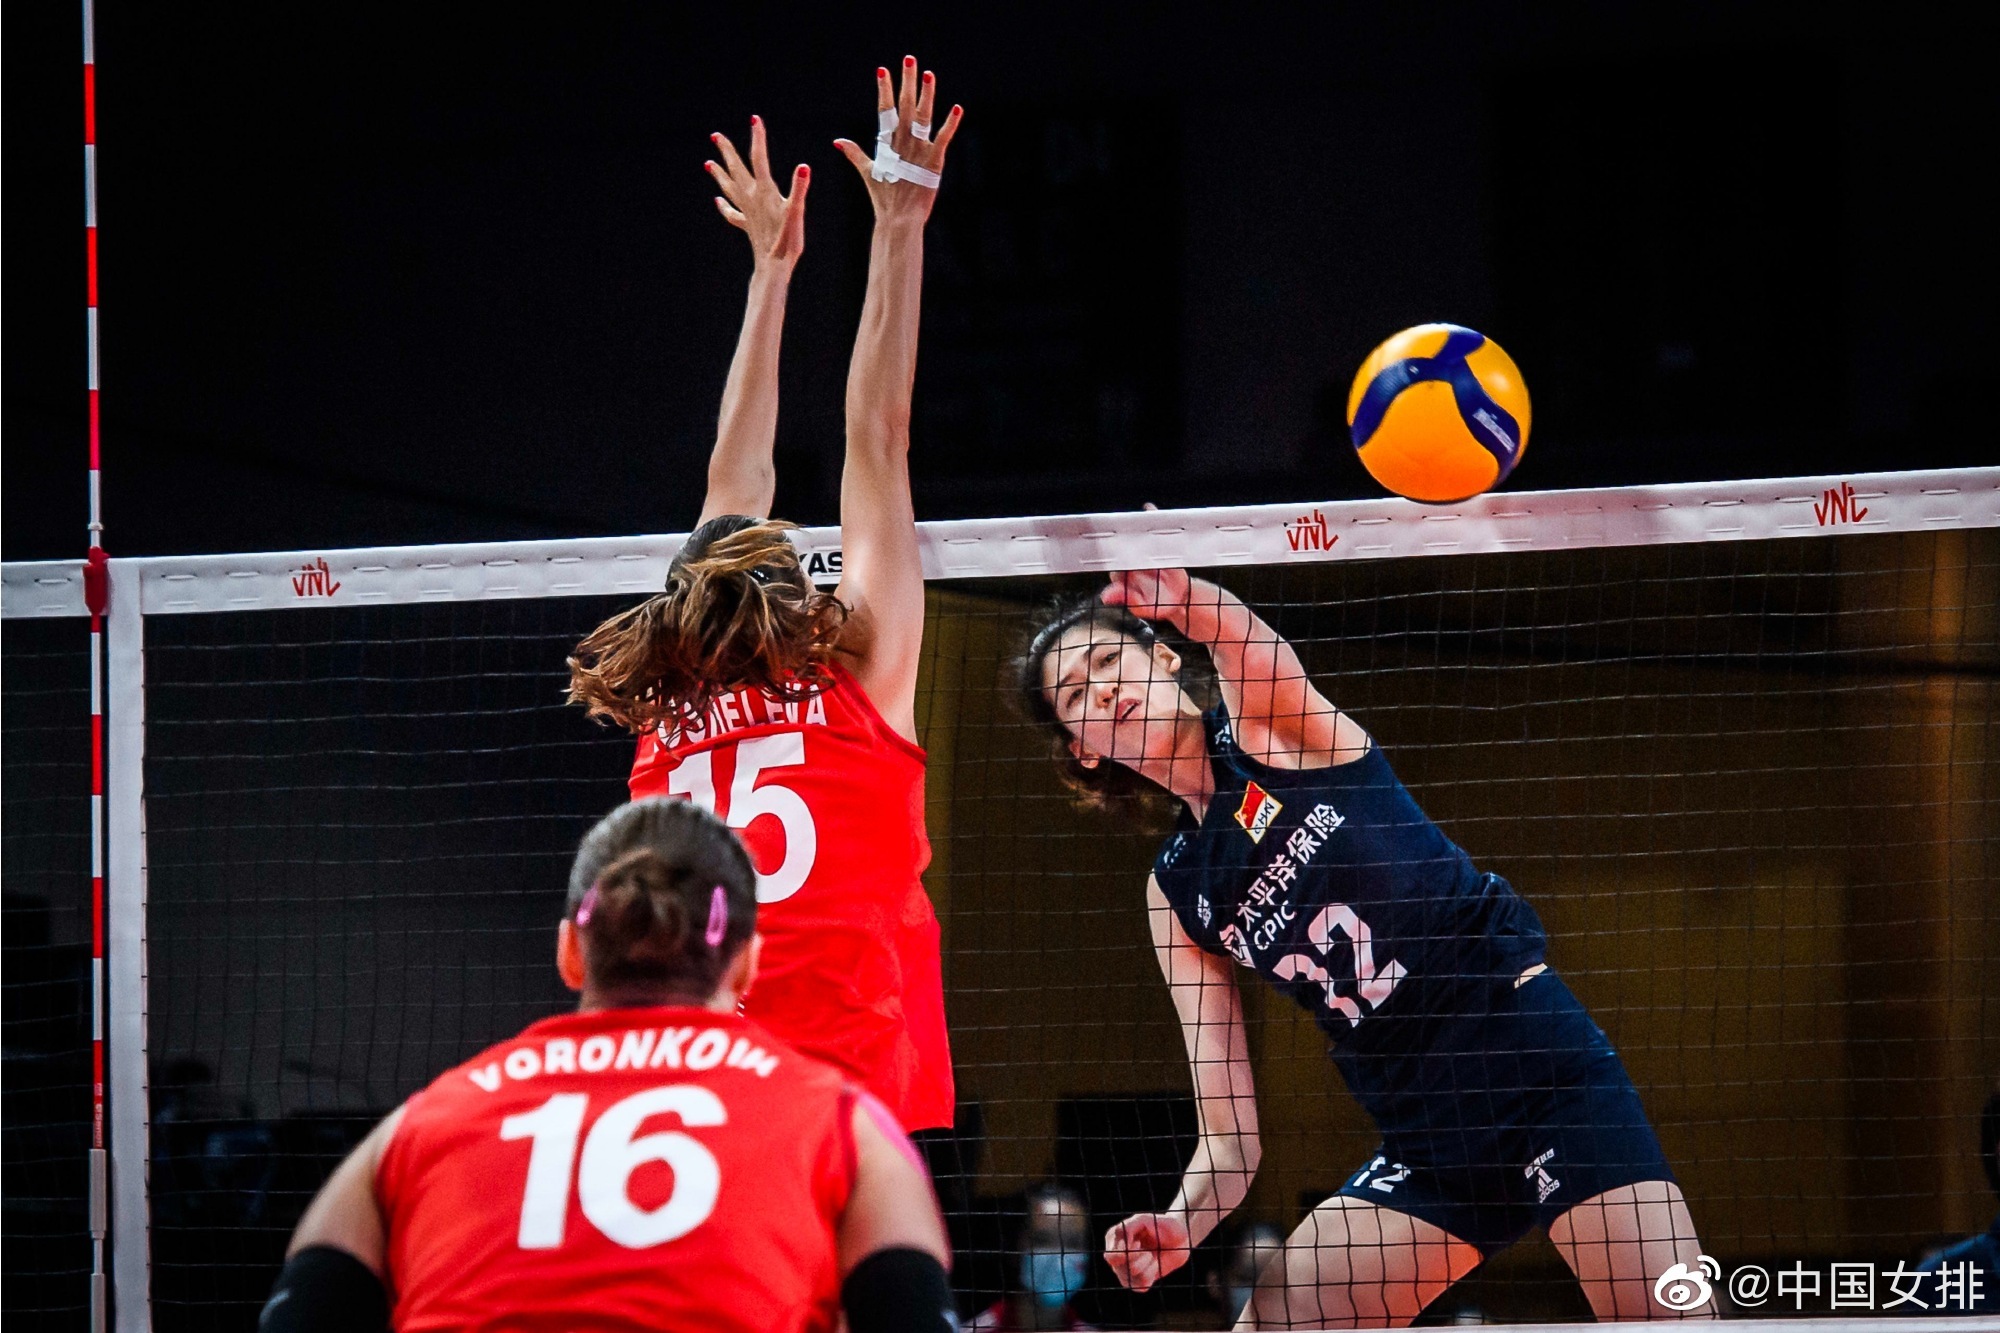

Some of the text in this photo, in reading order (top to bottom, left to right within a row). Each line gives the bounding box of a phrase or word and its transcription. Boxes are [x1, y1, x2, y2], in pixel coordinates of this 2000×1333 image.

[1814, 481, 1868, 527] VNL
[1286, 508, 1339, 552] VNL
[292, 556, 341, 597] VNL
[799, 551, 843, 577] AS
[668, 731, 817, 904] 15
[1254, 802, 1275, 835] CHN
[1236, 803, 1346, 932] 太平洋保险
[1253, 900, 1297, 951] CPIC
[499, 1083, 728, 1250] 16
[1352, 1156, 1411, 1194] 12
